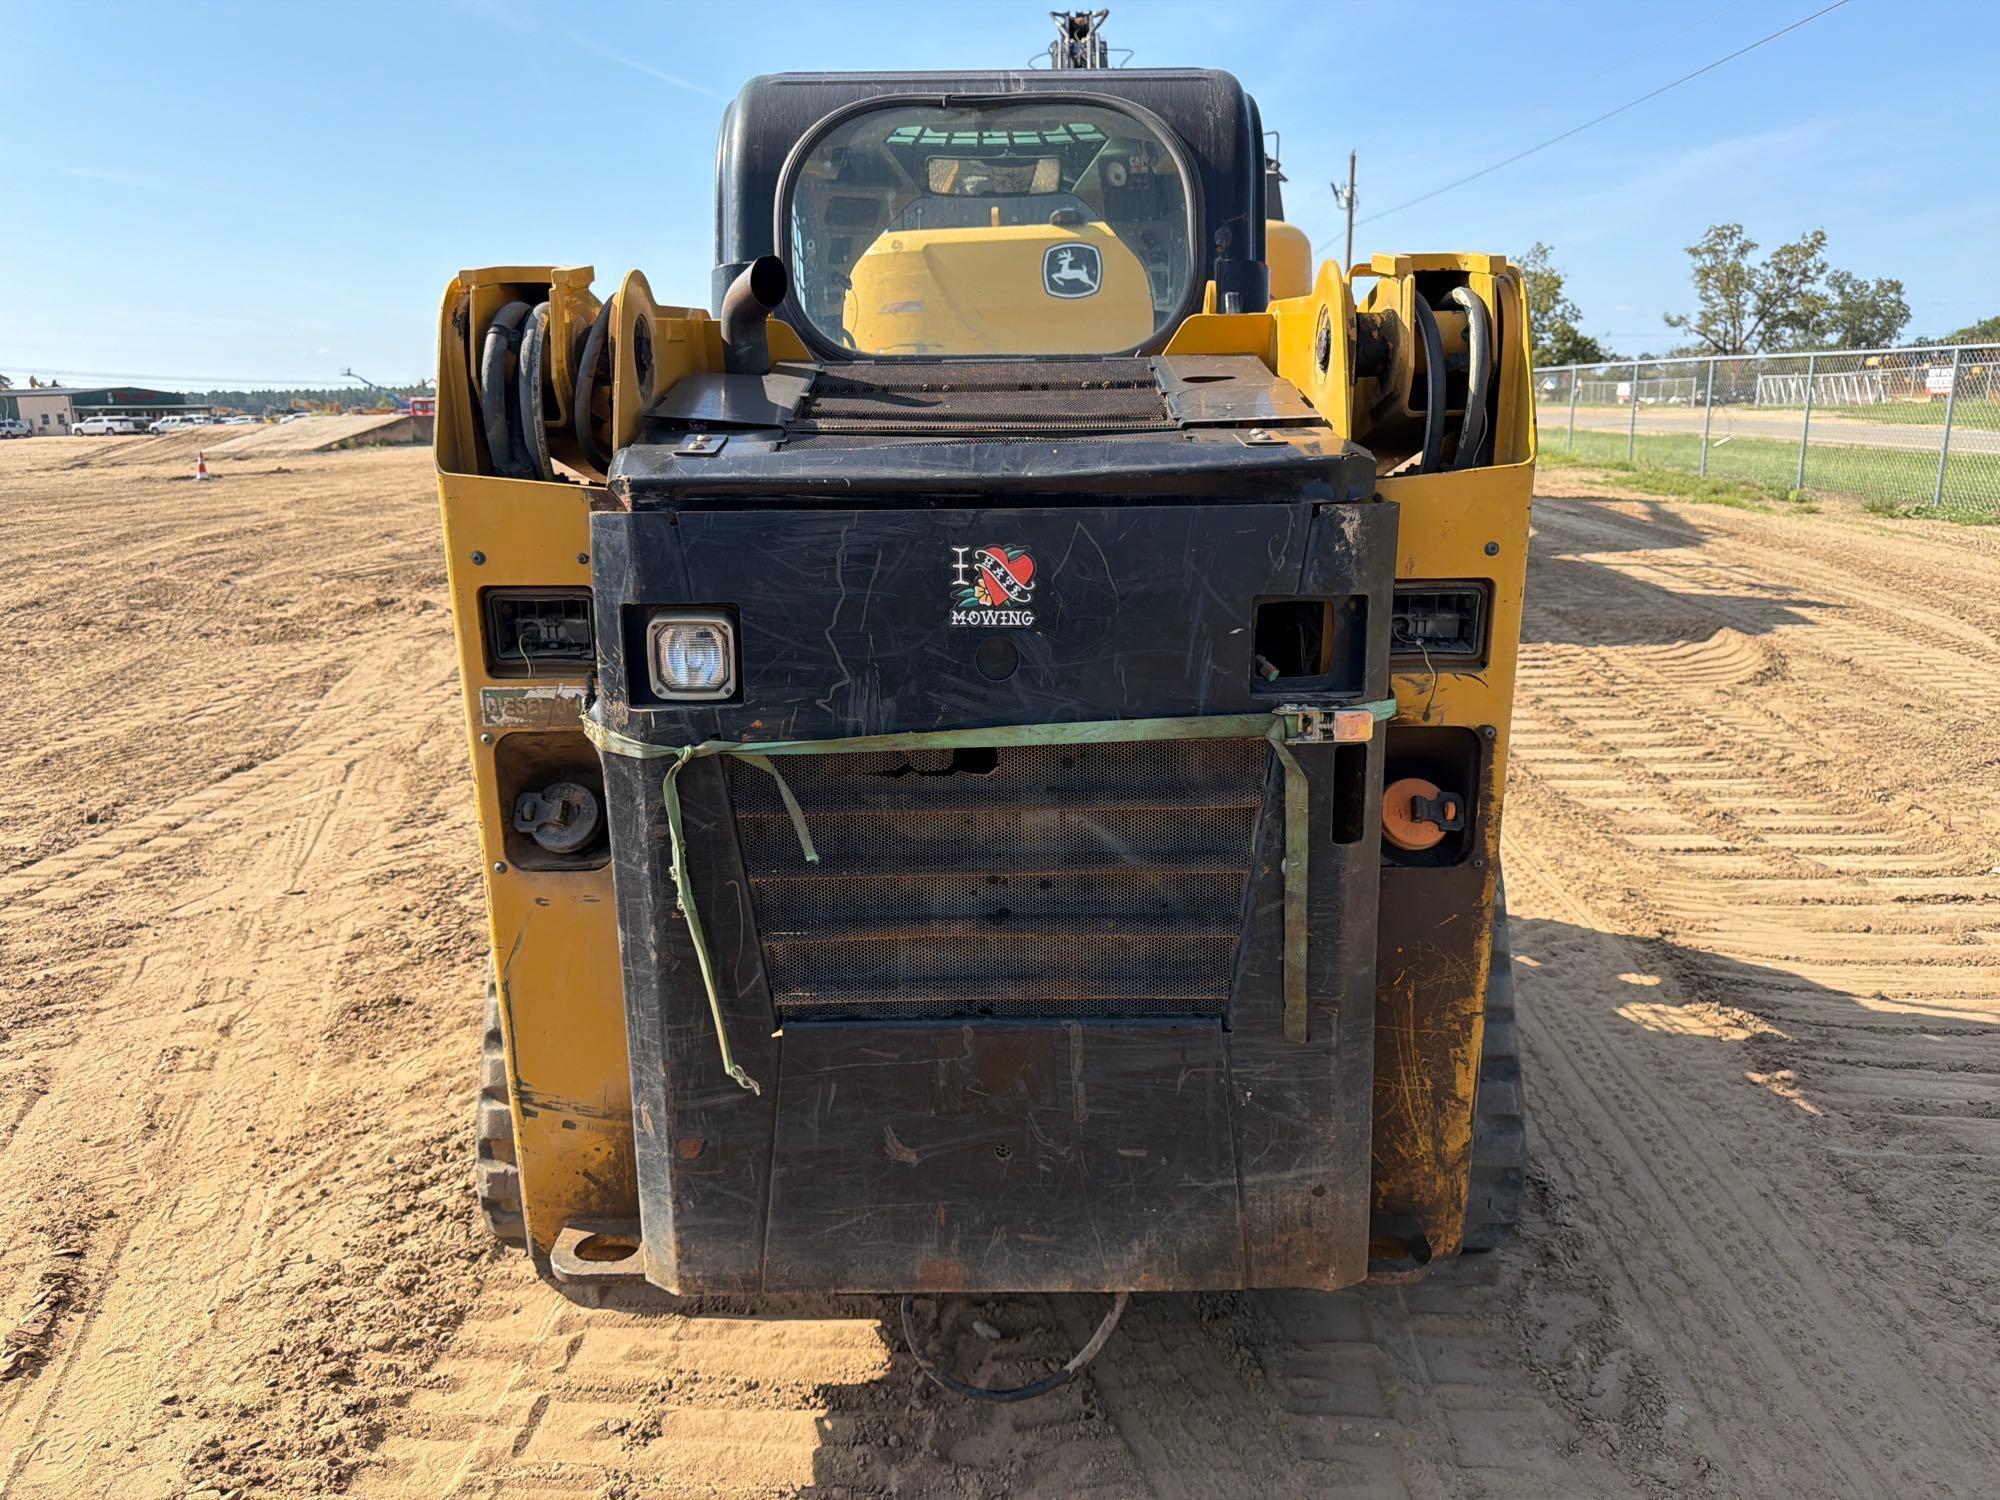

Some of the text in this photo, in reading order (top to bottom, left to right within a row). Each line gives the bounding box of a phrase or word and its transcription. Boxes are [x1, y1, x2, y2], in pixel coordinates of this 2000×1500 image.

[951, 546, 1022, 597] I HATE
[951, 609, 1035, 626] MOWING
